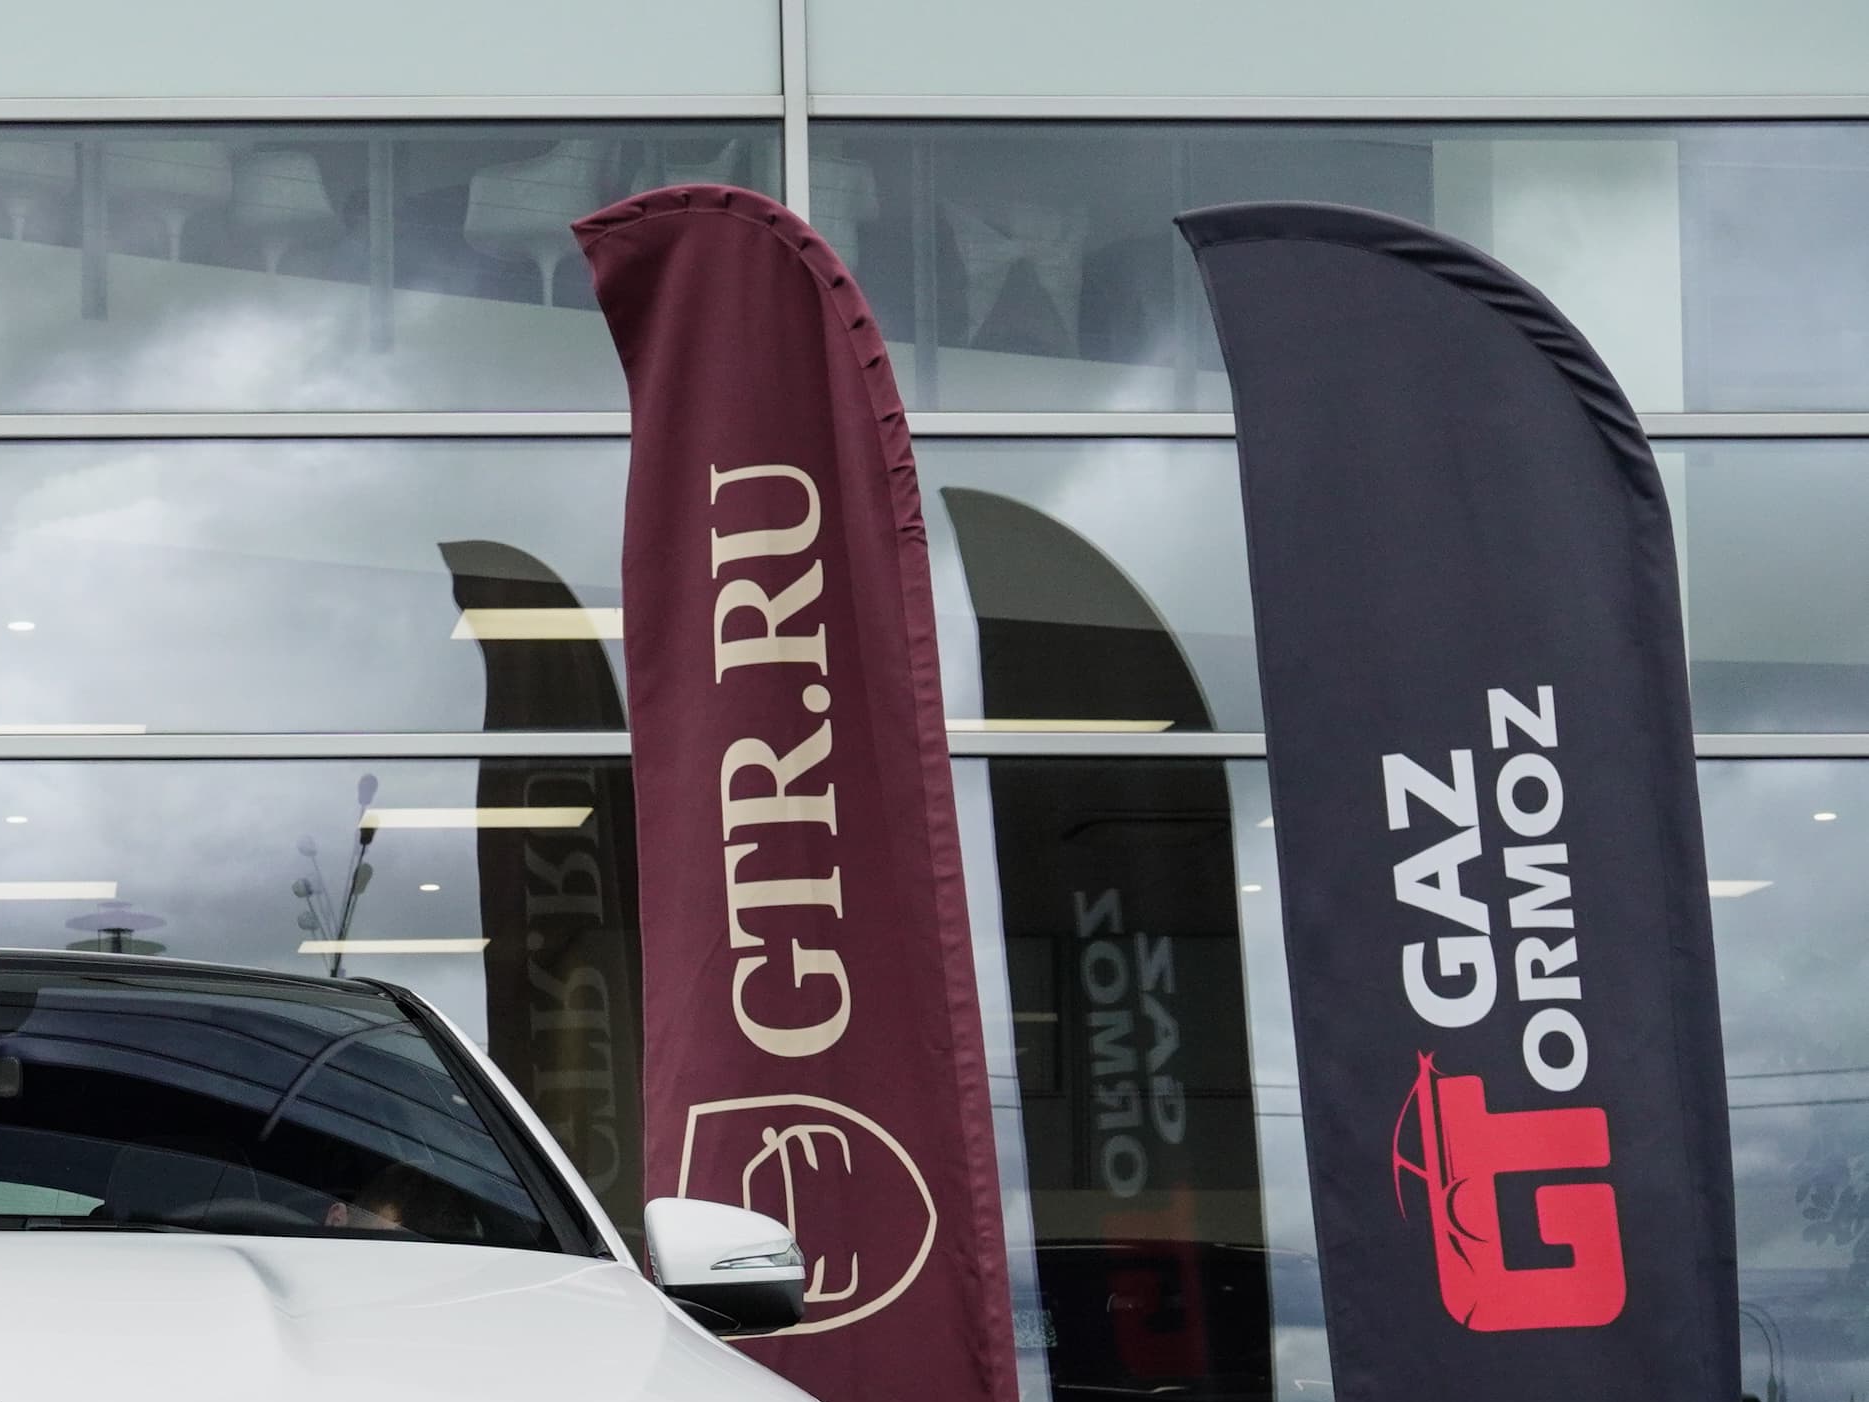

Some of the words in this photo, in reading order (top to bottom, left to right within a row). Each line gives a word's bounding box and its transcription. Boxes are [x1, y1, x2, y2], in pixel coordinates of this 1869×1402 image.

[710, 463, 852, 1059] GTR.RU
[1382, 749, 1498, 1029] GAZ
[1487, 685, 1590, 1093] ORMOZ
